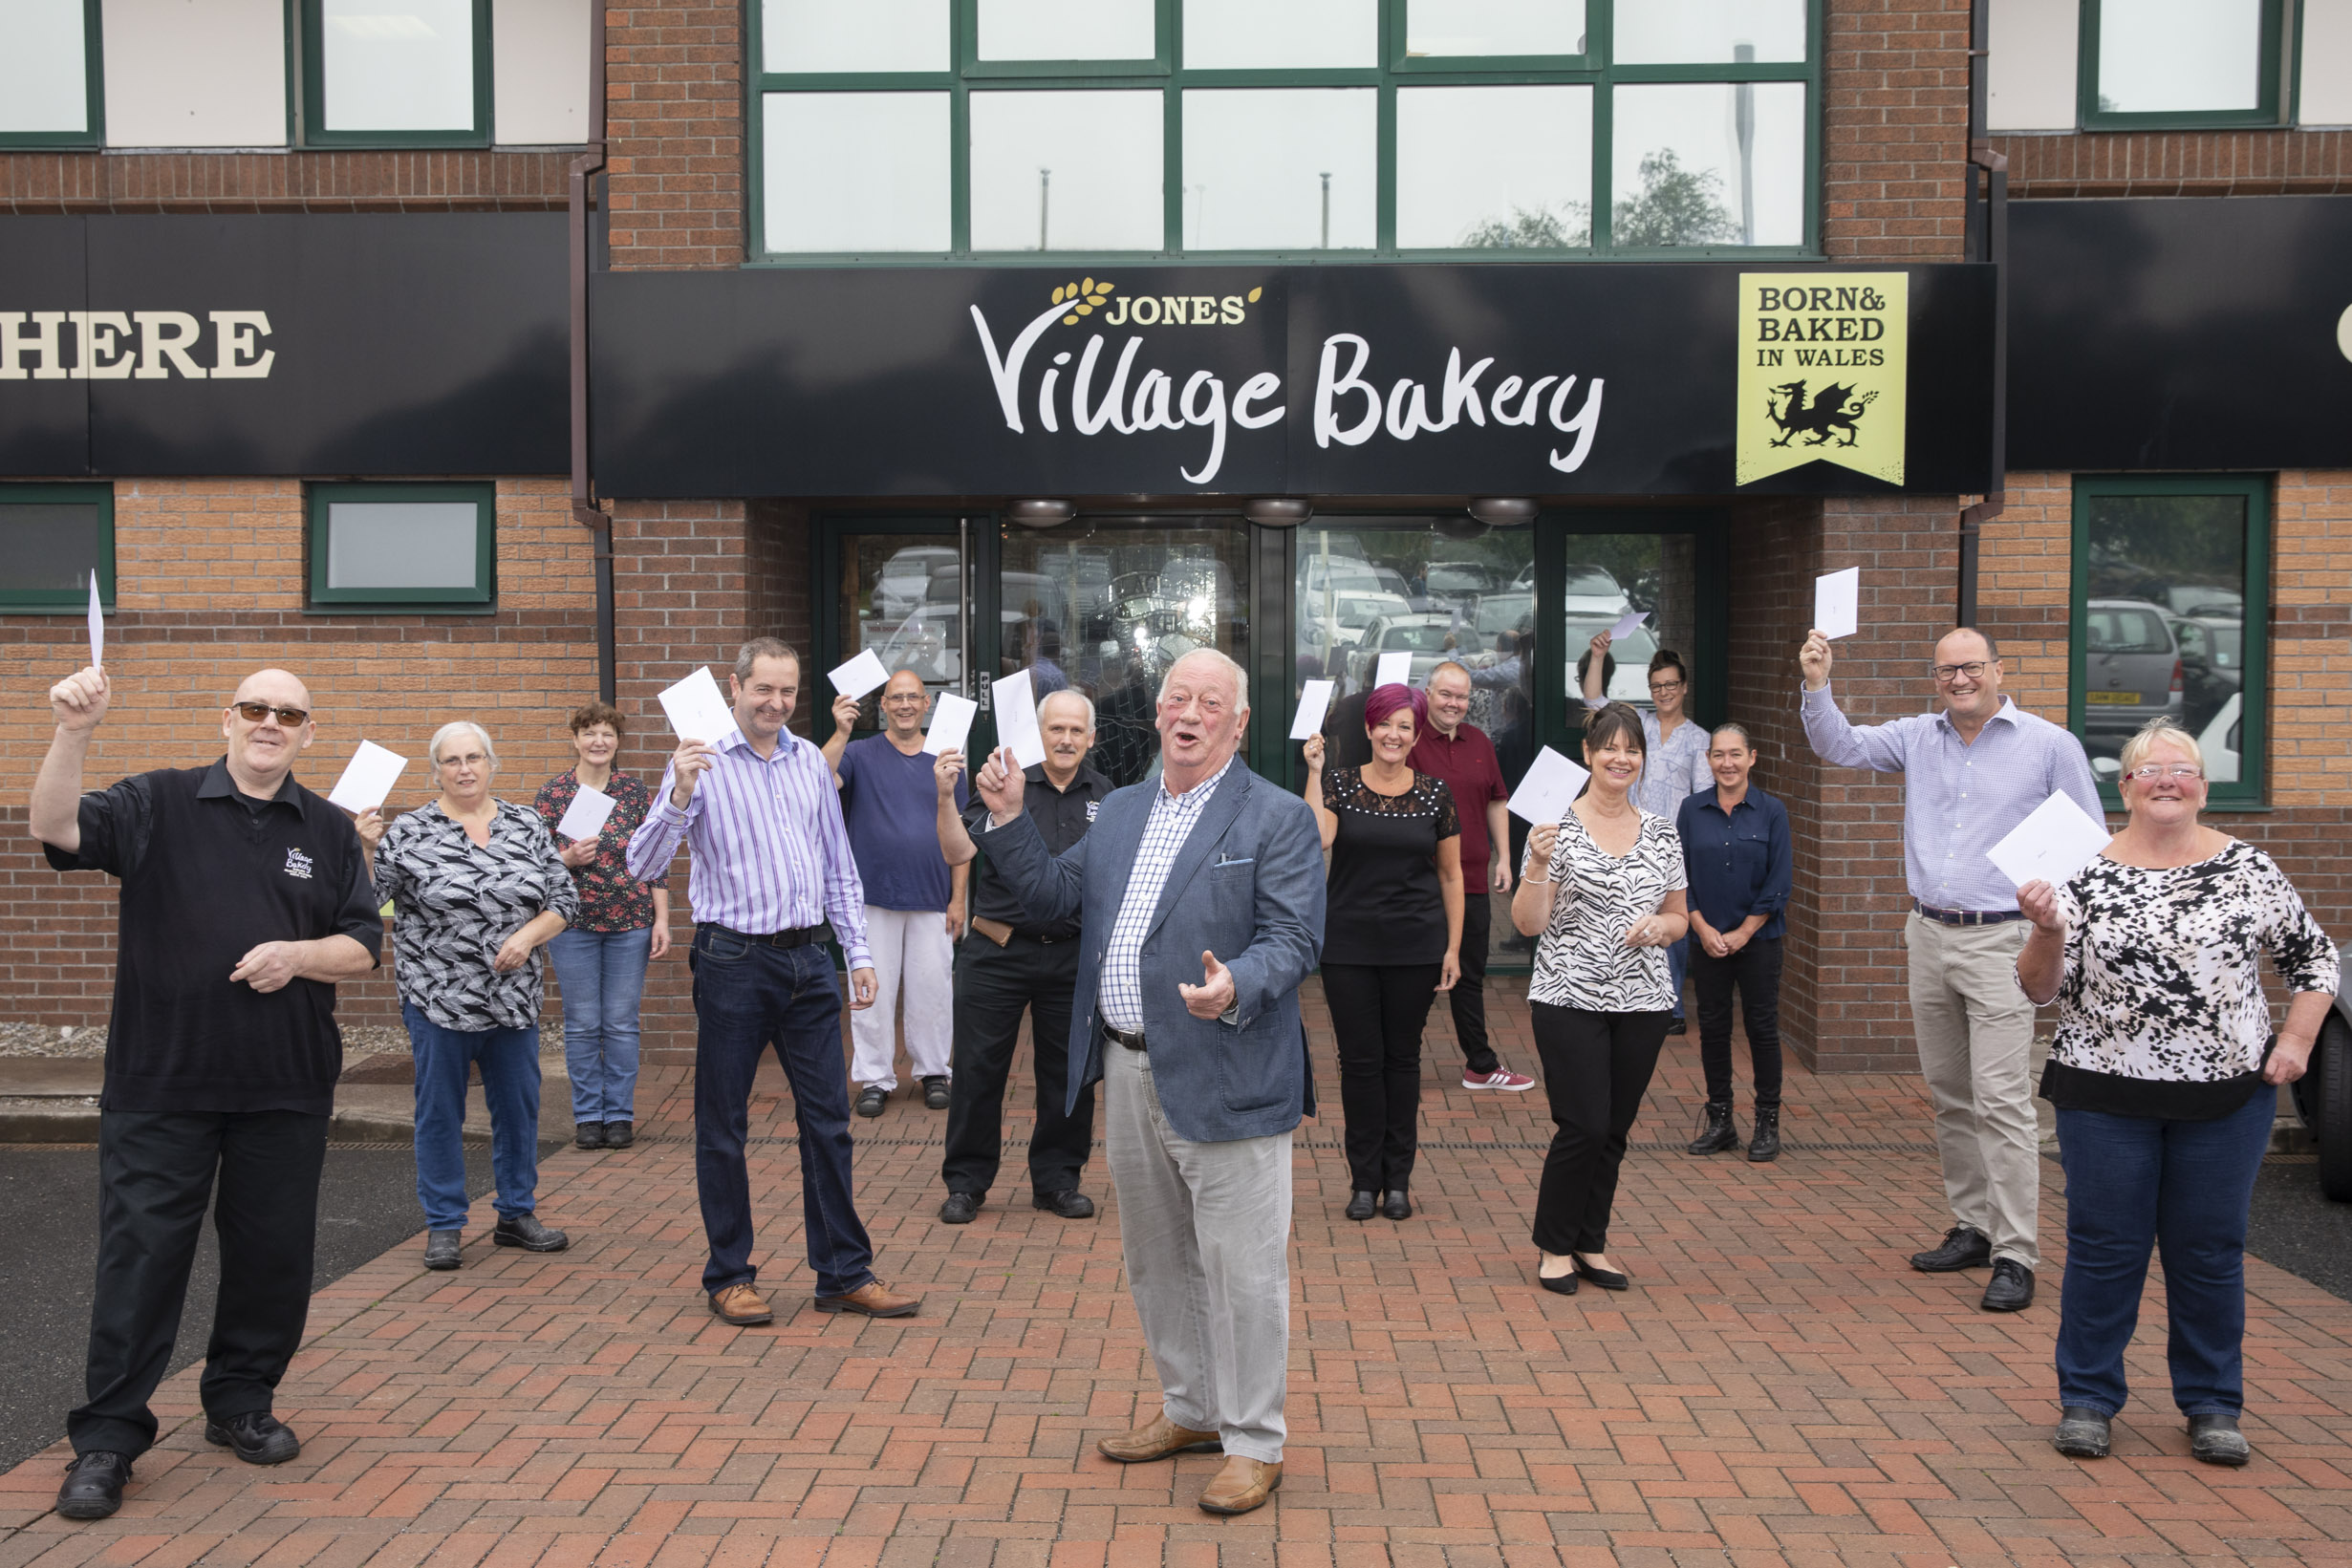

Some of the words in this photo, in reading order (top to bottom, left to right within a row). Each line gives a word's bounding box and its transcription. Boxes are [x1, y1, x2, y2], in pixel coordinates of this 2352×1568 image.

[1759, 287, 1886, 311] BORN&
[1758, 317, 1885, 341] BAKED
[0, 311, 275, 379] HERE
[1757, 349, 1784, 366] IN
[1794, 349, 1885, 366] WALES
[971, 299, 1286, 484] Village
[1314, 333, 1605, 474] Bakery
